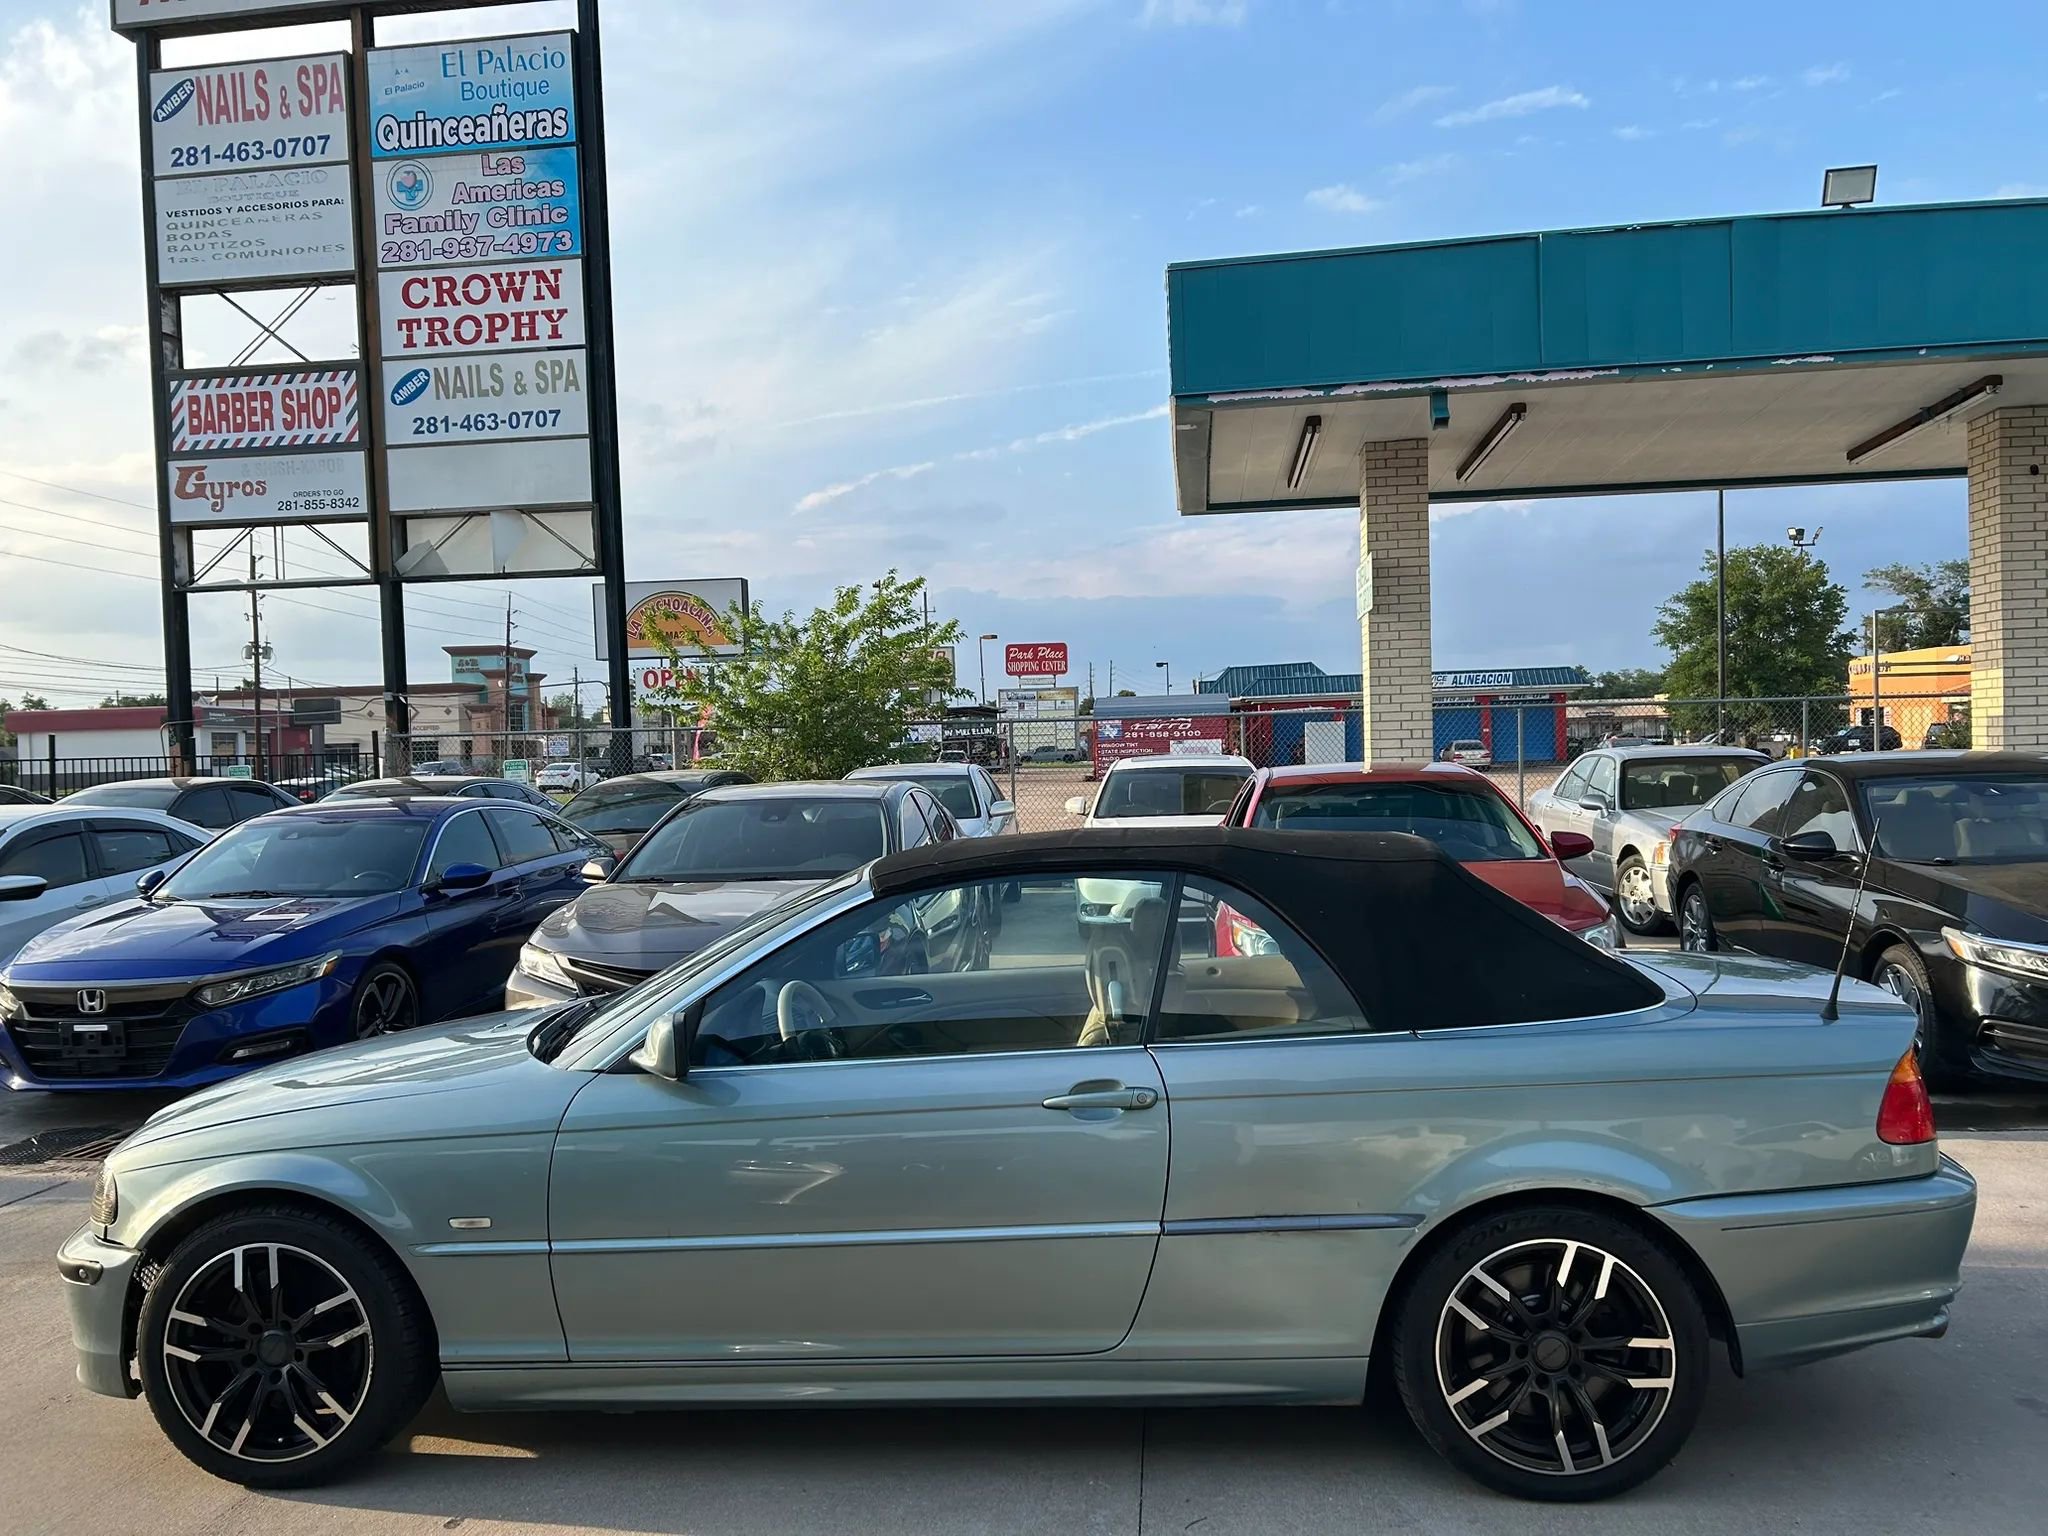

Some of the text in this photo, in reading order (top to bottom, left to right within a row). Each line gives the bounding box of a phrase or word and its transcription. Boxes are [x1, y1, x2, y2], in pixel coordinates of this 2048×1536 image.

[441, 49, 466, 78] El
[156, 82, 195, 121] AMBER
[195, 62, 345, 126] NAILS & SPA
[384, 81, 425, 96] El Palacio
[461, 78, 550, 101] Boutique
[376, 103, 568, 151] Quinceañeras
[170, 134, 331, 168] 281-463-0707
[481, 153, 526, 177] Las
[451, 178, 566, 204] Americas
[166, 198, 345, 218] VESTIDOS Y ACCESORIOS PARA:
[384, 203, 568, 235] Family Clinic
[166, 229, 233, 242] BODAS
[167, 238, 266, 253] BAUTIZOS
[381, 229, 573, 263] 281-937-4973
[212, 243, 345, 261] COMUNIONES
[401, 268, 563, 309] CROWN
[397, 308, 568, 349] TROPHY
[393, 370, 429, 404] AMBER
[433, 358, 581, 401] NAILS & SPA
[187, 386, 342, 435] BARBER SHOP
[412, 409, 561, 435] 281-463-0707
[174, 465, 267, 513] Gyros
[293, 490, 321, 498] ORDERS
[277, 497, 360, 511] 281-855-8342
[627, 619, 643, 639] LA
[1007, 660, 1067, 672] SHOPPING CENTER
[1009, 646, 1065, 660] Park Place
[1451, 673, 1511, 685] ALINEACION
